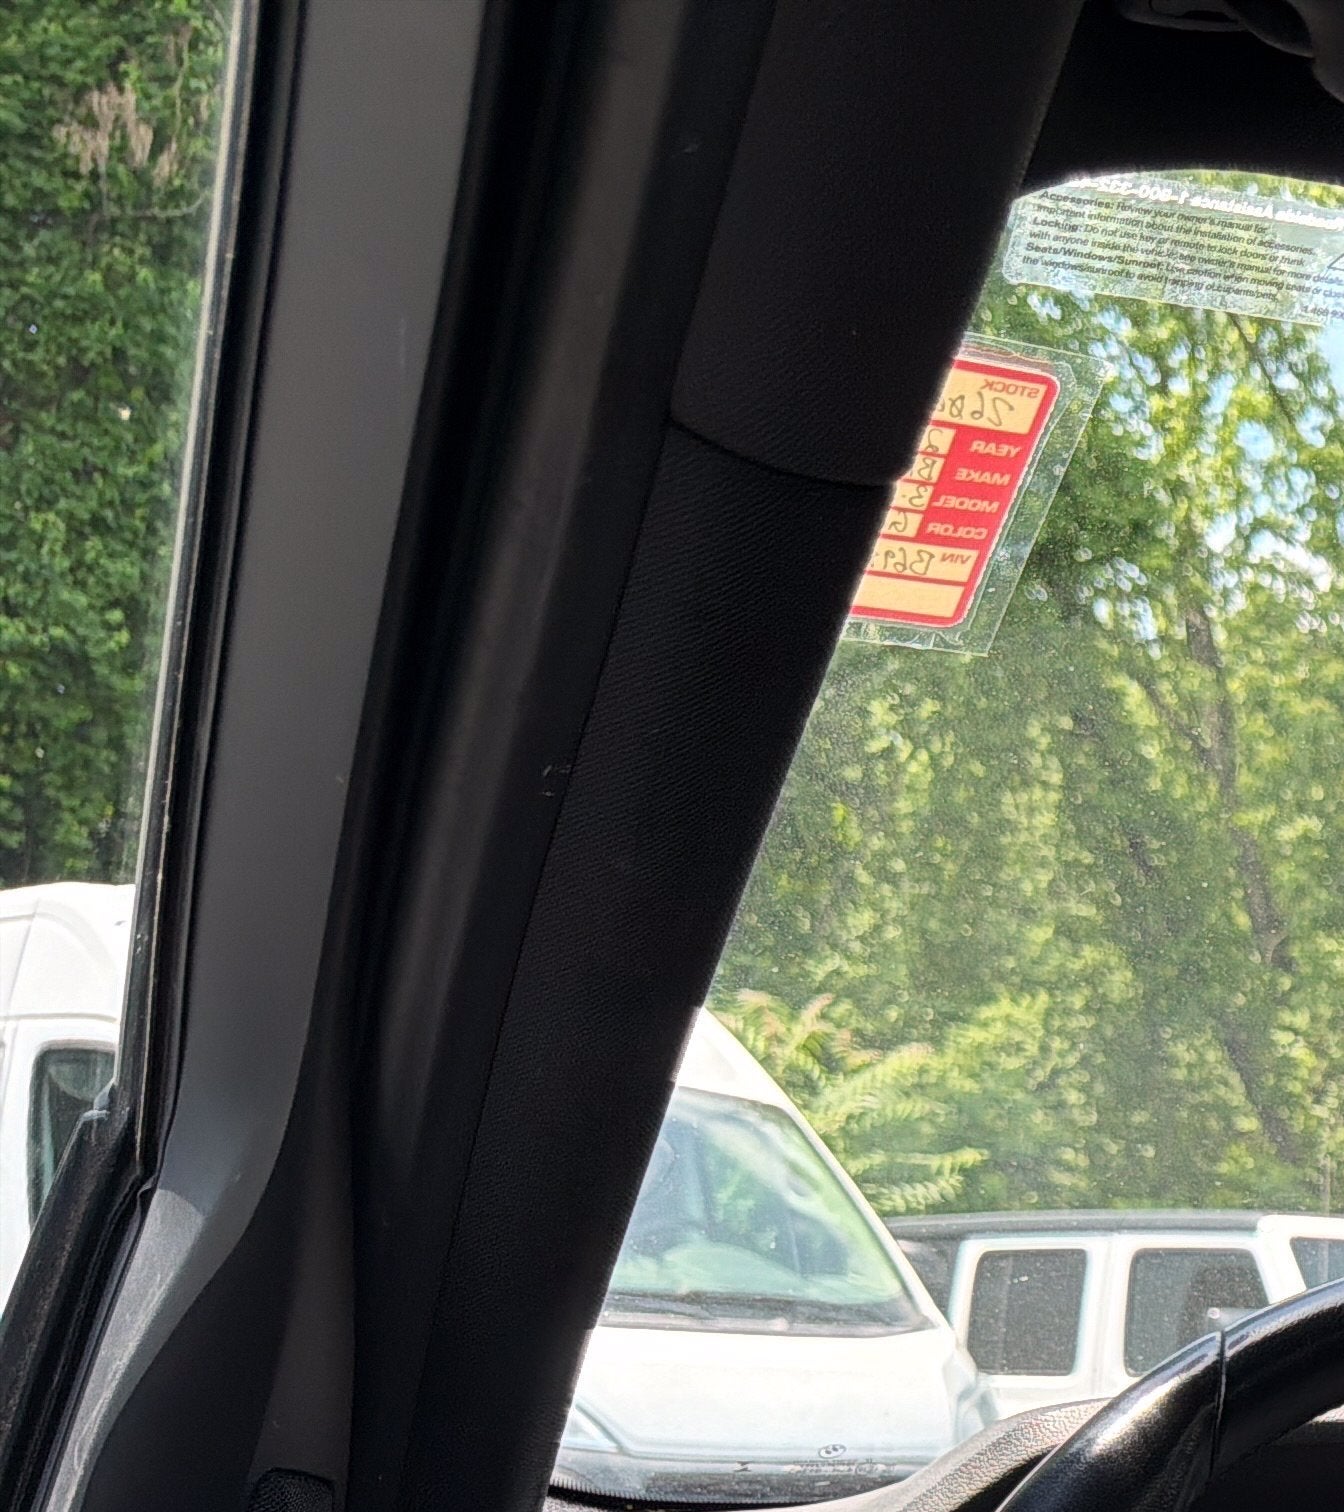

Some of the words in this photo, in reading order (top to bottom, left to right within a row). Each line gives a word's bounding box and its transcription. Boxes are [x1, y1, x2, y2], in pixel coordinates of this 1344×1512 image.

[1039, 190, 1113, 209] Accessories:
[1117, 202, 1152, 216] Review
[1153, 208, 1176, 219] your
[1177, 212, 1215, 225] owner's
[1217, 219, 1252, 232] manual
[1254, 224, 1268, 234] for
